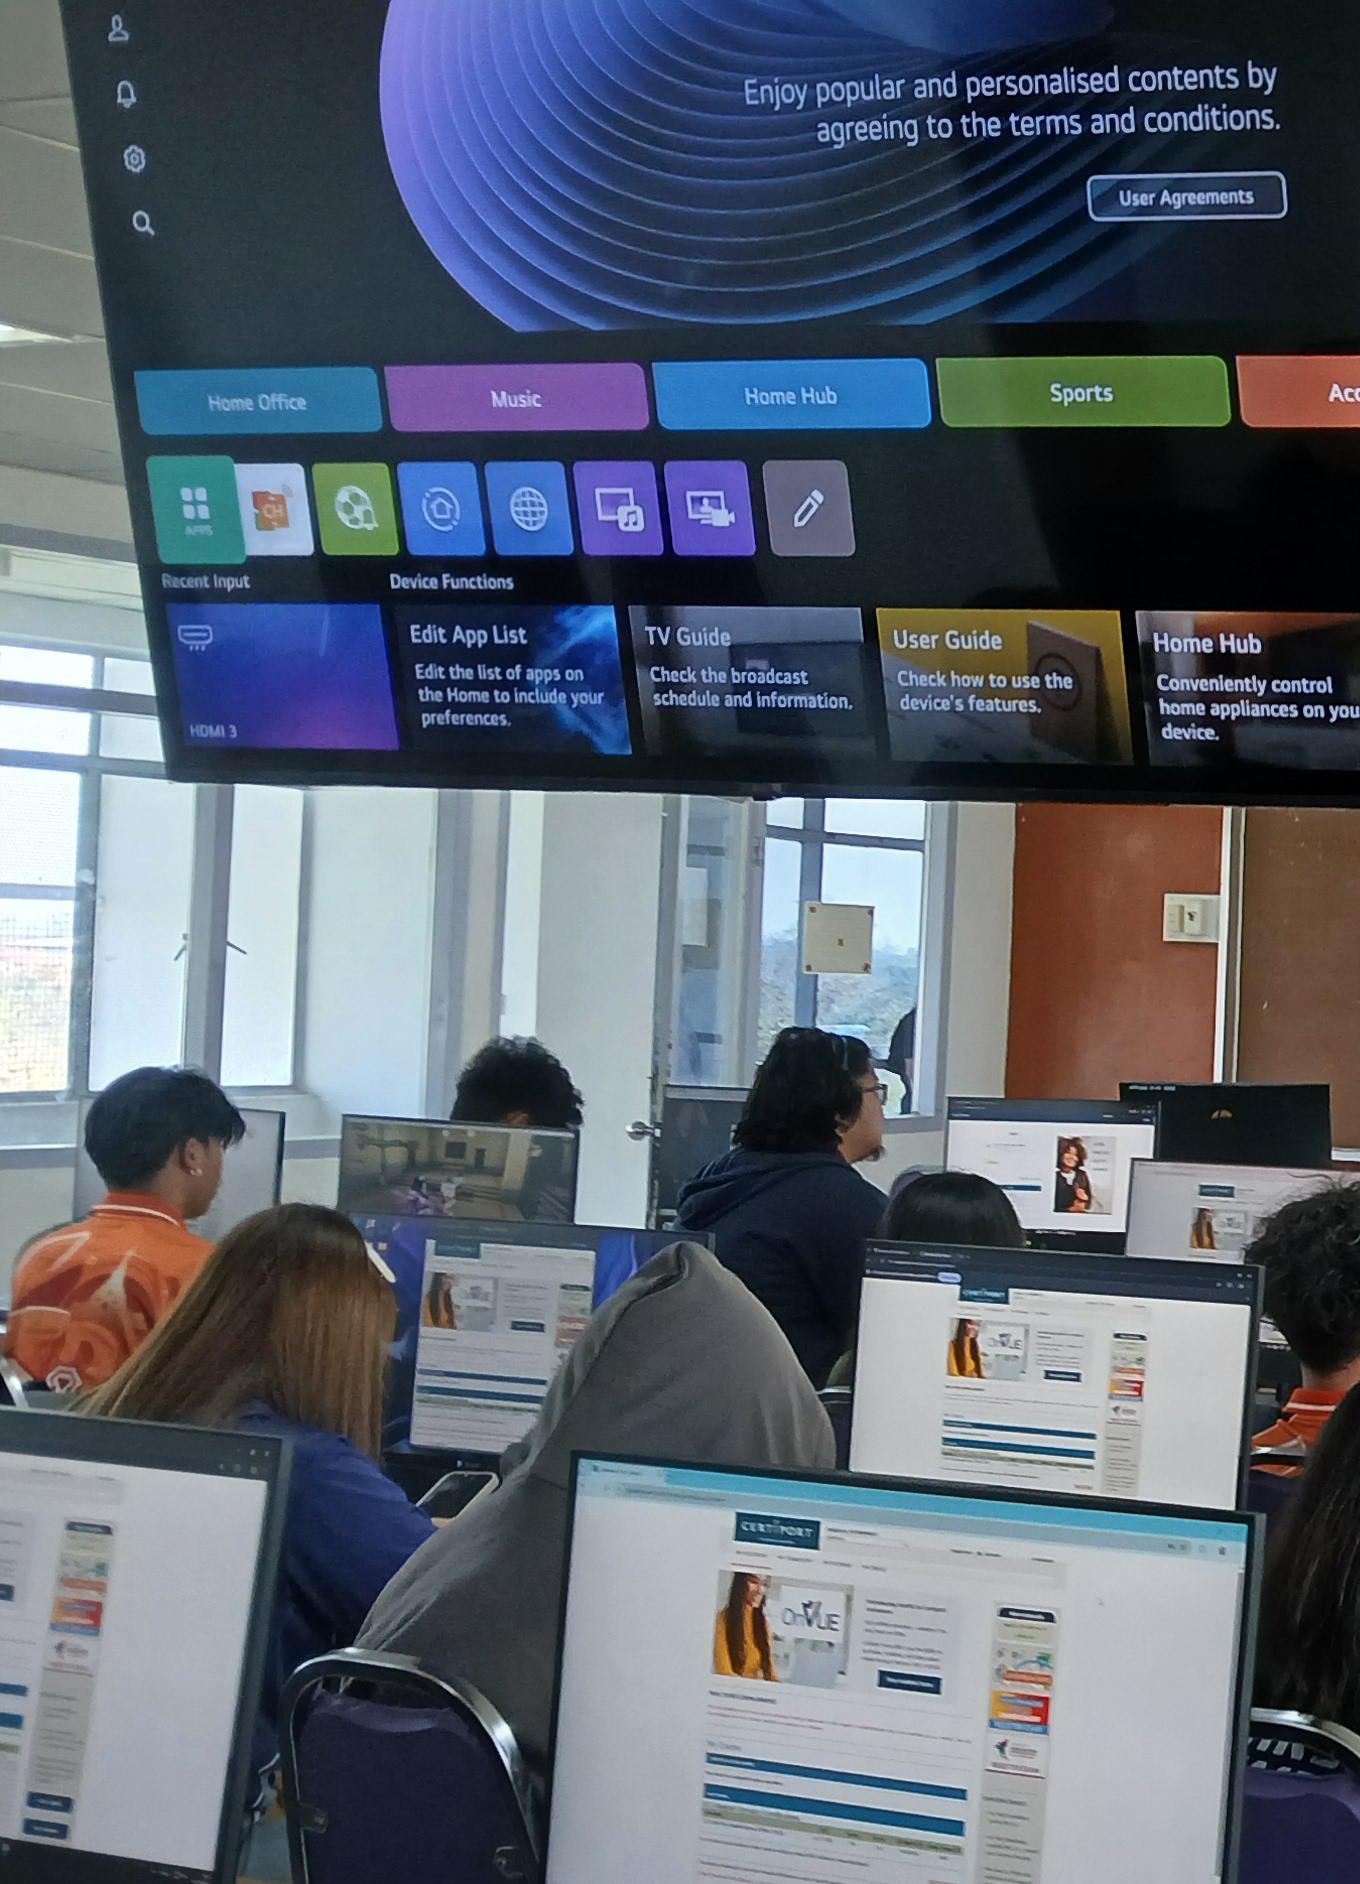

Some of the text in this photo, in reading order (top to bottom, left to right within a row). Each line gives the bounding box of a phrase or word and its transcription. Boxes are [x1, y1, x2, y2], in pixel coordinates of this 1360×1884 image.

[745, 60, 1277, 110] Enjoy popular and personalised contents by
[817, 103, 1280, 148] agreeing to the terms and conditions.
[1119, 186, 1254, 209] User Agreements
[208, 392, 306, 413] Home Office
[492, 389, 542, 409] Music
[745, 385, 837, 405] Home Hub
[1050, 382, 1113, 405] Sports
[162, 573, 250, 592] Recent Input
[390, 573, 514, 591] Device Functions
[410, 624, 527, 649] Edit App List
[645, 626, 731, 647] TV Guide
[893, 630, 1002, 651] User Guide
[1154, 633, 1262, 655] Home Hub
[415, 664, 584, 685] Edit the list of apps on
[650, 667, 808, 686] Check the broadcast
[898, 670, 1073, 690] Check how to use the
[1157, 674, 1333, 696] Conveniently control
[418, 687, 604, 708] the Home to include your
[653, 690, 719, 707] schedule
[723, 691, 752, 708] and
[900, 694, 1042, 715] device's features.
[422, 709, 511, 730] preferences.
[1160, 698, 1206, 718] home
[1210, 700, 1298, 721] appliances
[1303, 703, 1325, 719] on
[190, 724, 237, 739] HDMI 3
[1162, 723, 1219, 742] device.
